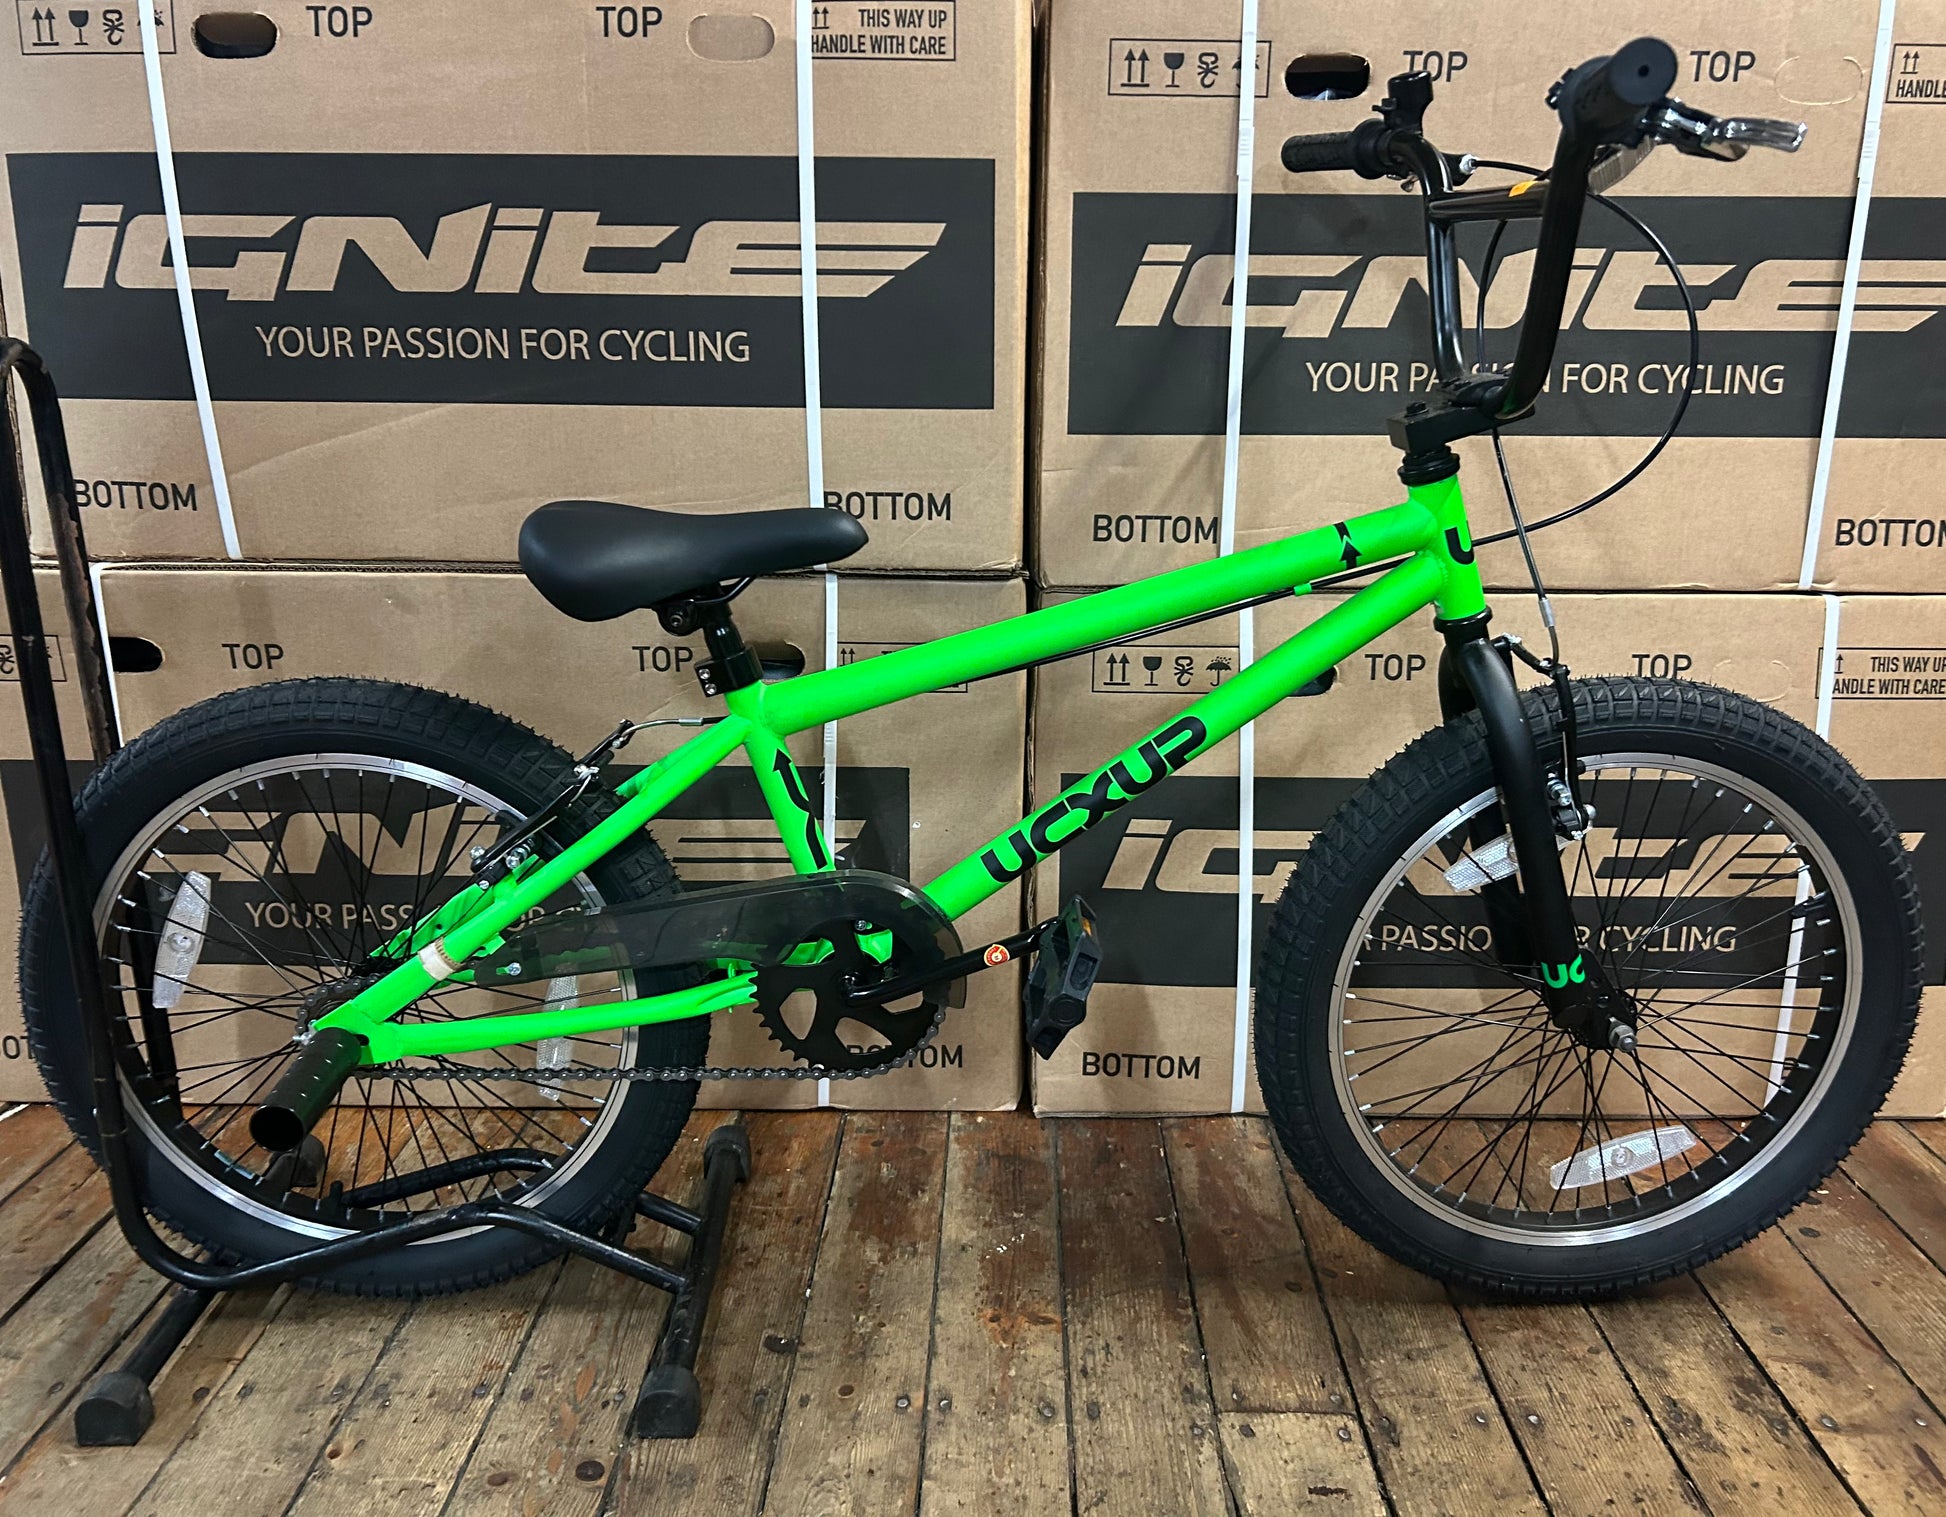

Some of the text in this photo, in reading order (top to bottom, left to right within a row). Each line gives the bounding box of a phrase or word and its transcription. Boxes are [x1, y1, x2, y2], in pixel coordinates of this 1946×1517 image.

[306, 6, 373, 37] TOP
[596, 6, 662, 37] TOP
[858, 9, 947, 28] THIS WAY UP
[870, 35, 905, 54] WITH
[909, 36, 946, 55] CARE
[1403, 50, 1468, 82] TOP
[1690, 51, 1756, 82] TOP
[255, 327, 750, 363] YOUR PASSION FOR CYCLING
[1305, 362, 1399, 392] YOUR
[1561, 363, 1628, 394] FOR
[1637, 364, 1785, 396] CYCLING
[74, 479, 197, 512] BOTTOM
[1093, 515, 1218, 545] BOTTOM
[222, 643, 284, 670] TOP
[632, 646, 694, 672] TOP
[1364, 653, 1426, 681] TOP
[1631, 653, 1693, 680] TOP
[1870, 656, 1899, 673] THIS
[1903, 656, 1930, 673] WAY
[1832, 678, 1946, 695] ANDLE WITH CARE
[245, 902, 332, 929] YOUR
[1381, 924, 1492, 952] PASSIO
[1600, 925, 1736, 953] CYCLING
[1082, 1051, 1201, 1080] BOTTOM
